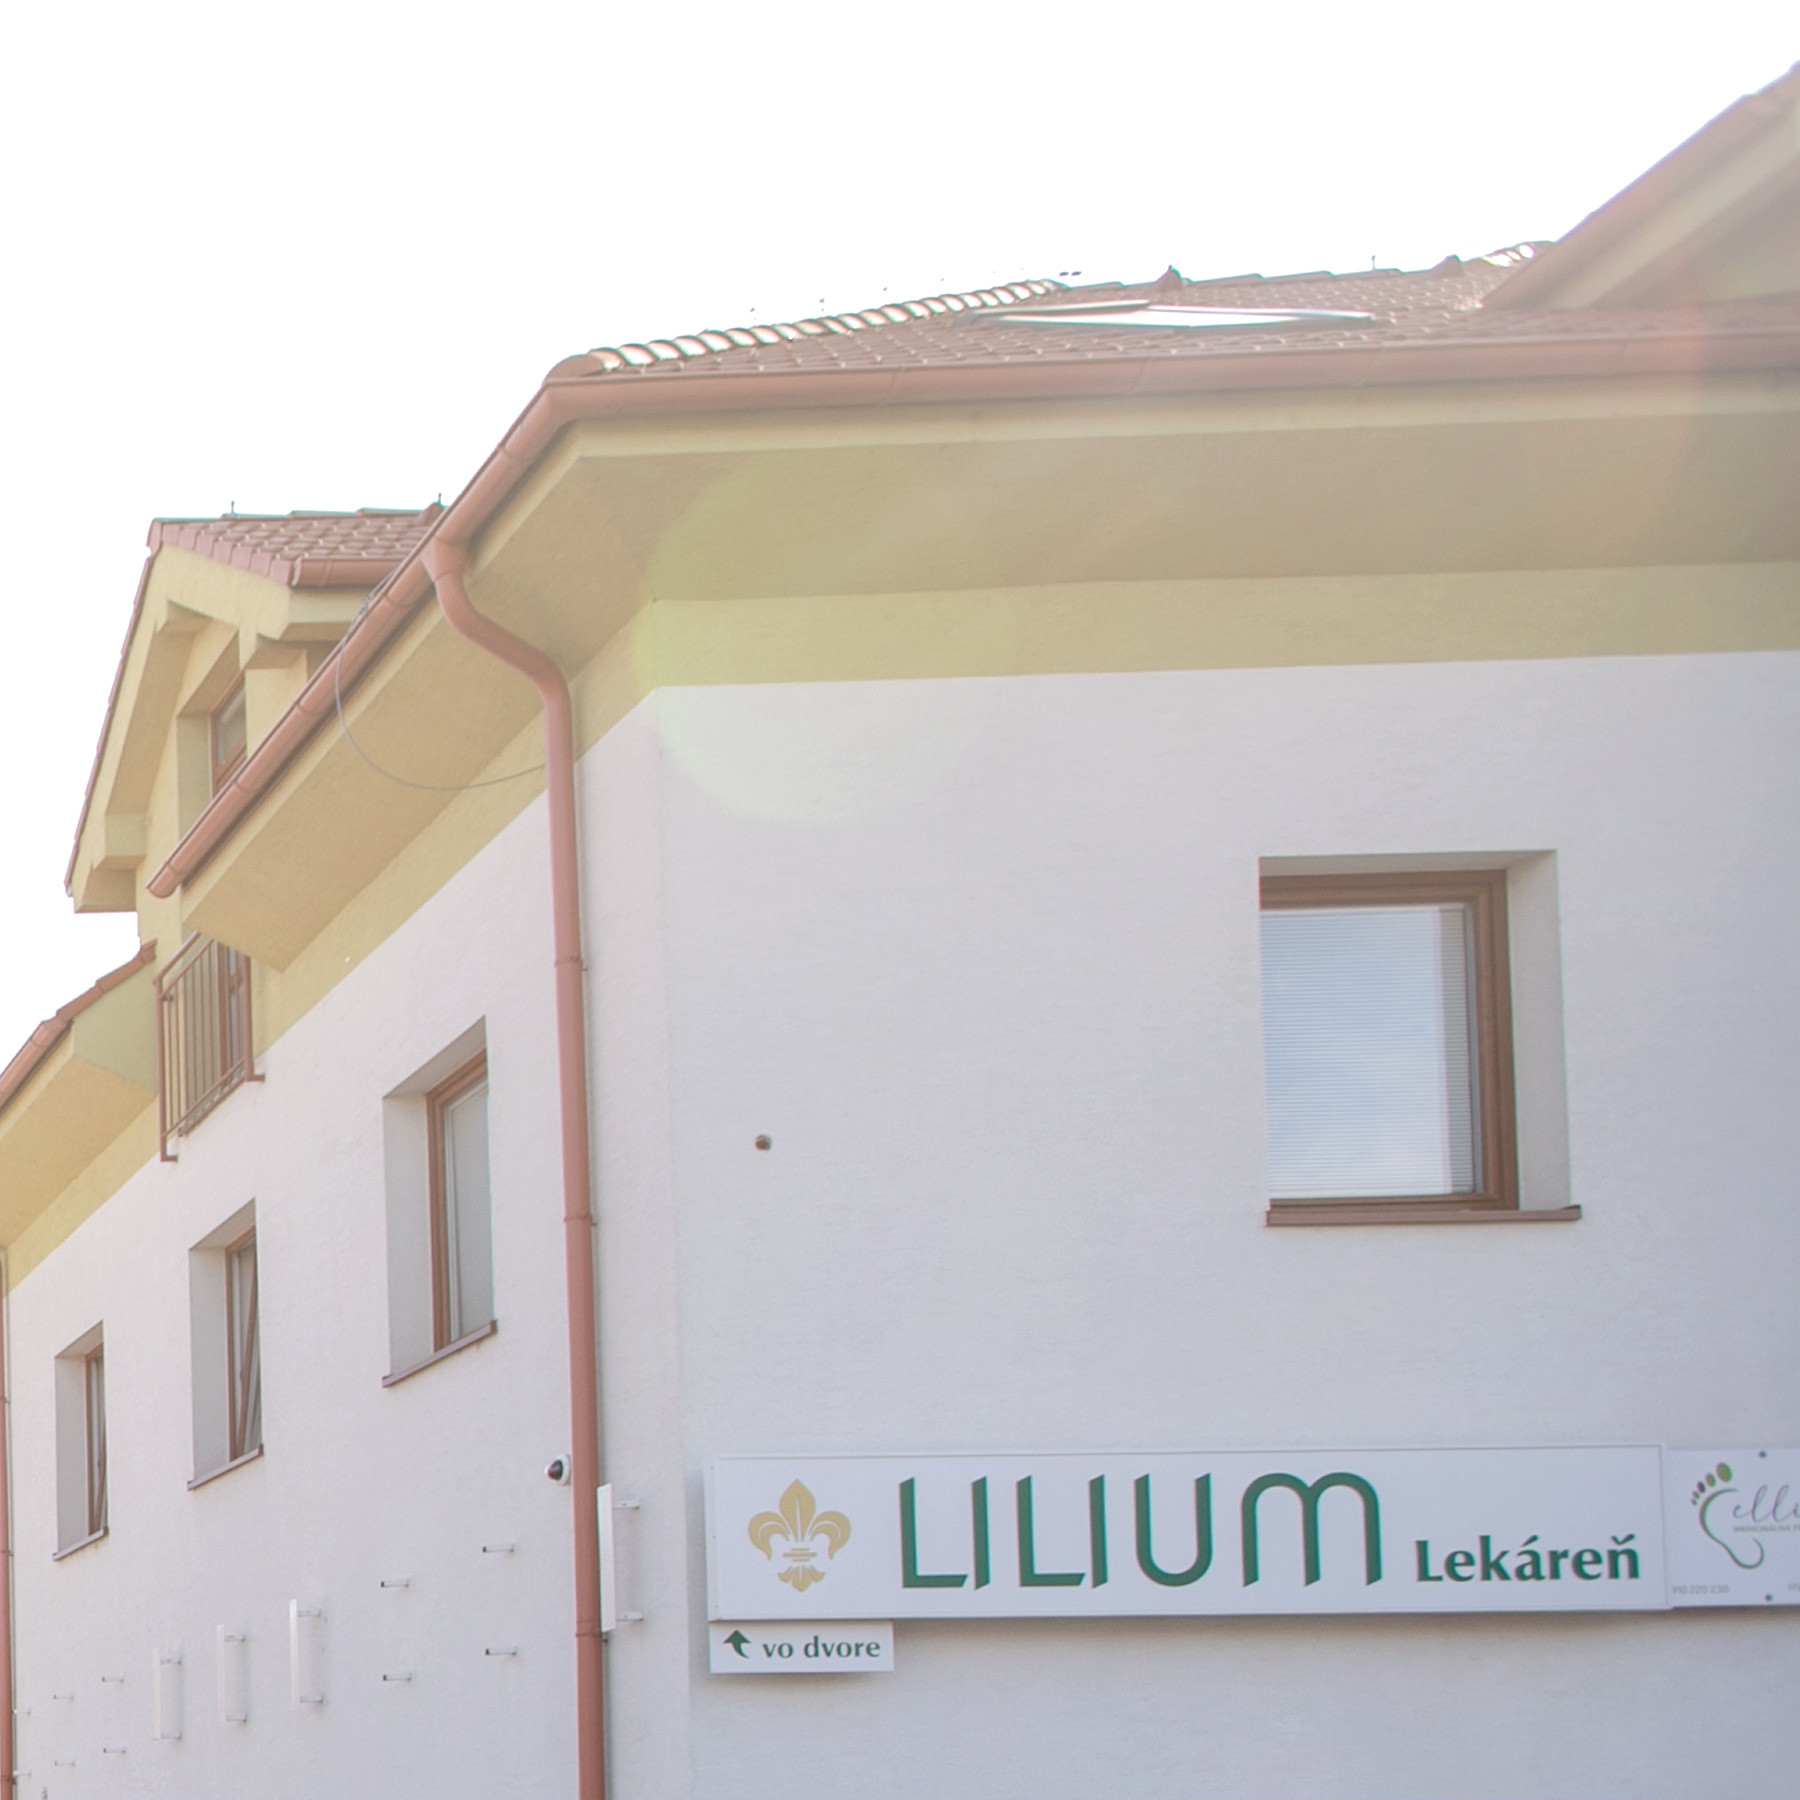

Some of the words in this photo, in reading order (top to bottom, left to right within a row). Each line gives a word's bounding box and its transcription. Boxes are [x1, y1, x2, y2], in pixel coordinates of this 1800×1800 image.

[899, 1471, 1384, 1591] LILIUM
[1415, 1534, 1641, 1583] Lekáreň
[763, 1642, 794, 1658] vo
[804, 1635, 881, 1658] dvore
